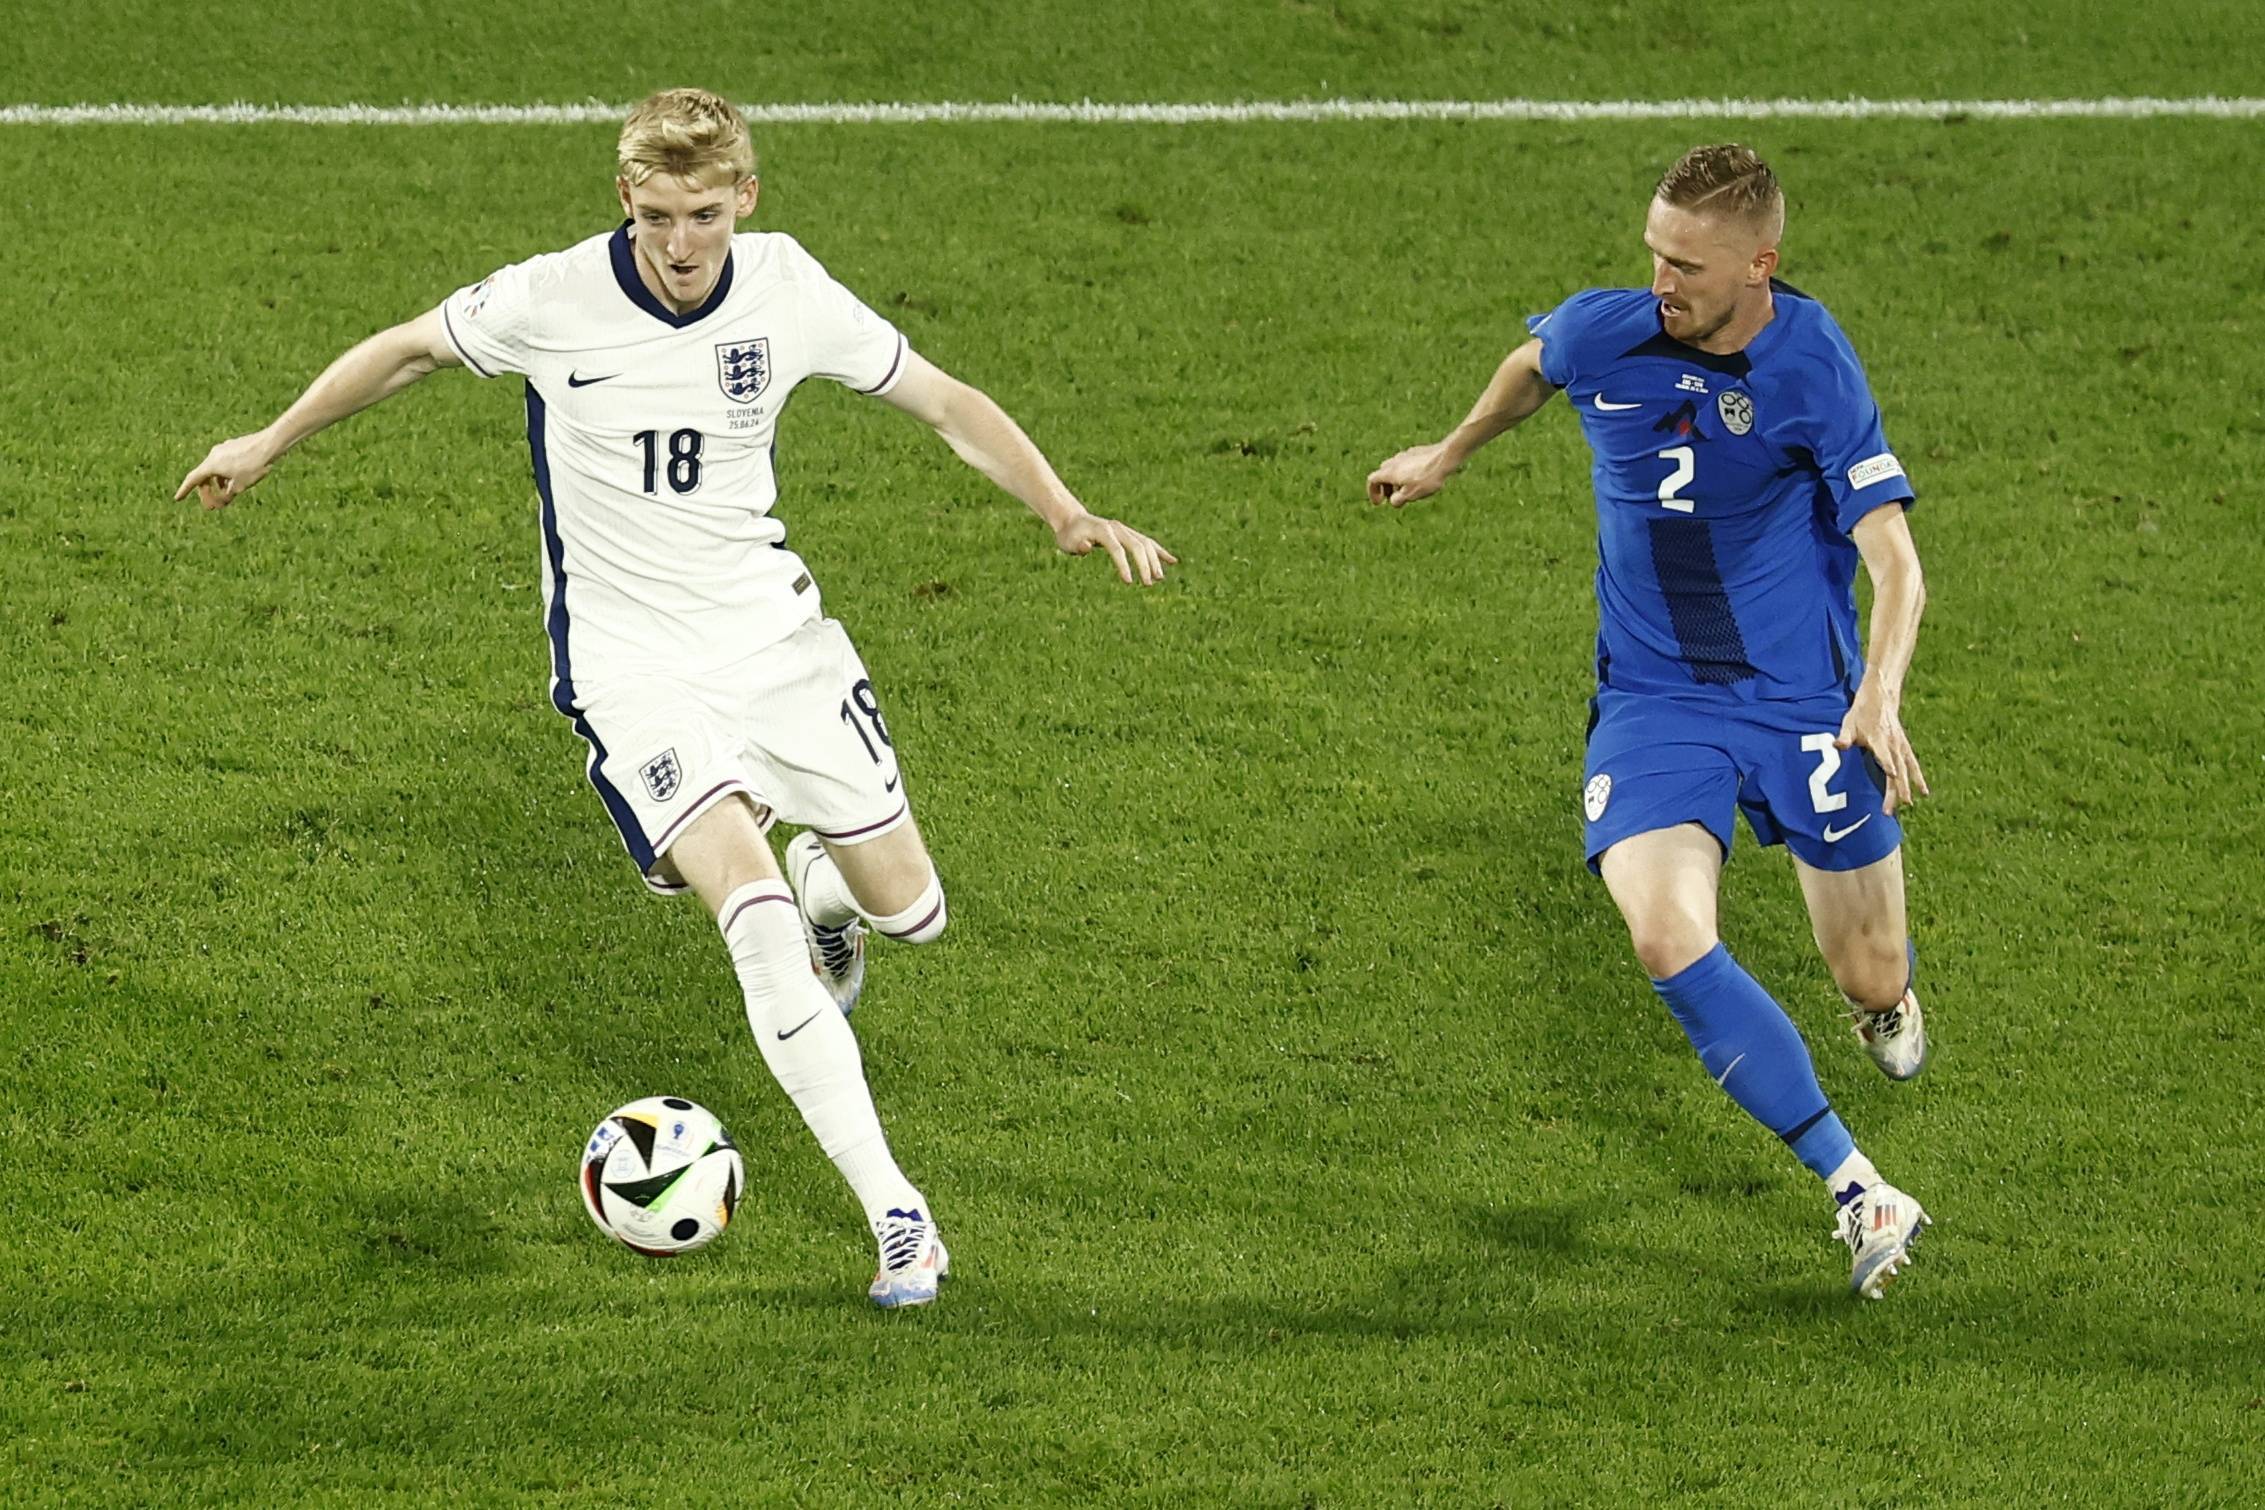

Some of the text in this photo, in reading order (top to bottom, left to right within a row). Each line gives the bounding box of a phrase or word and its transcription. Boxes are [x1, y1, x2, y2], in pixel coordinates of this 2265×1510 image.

[726, 407, 764, 419] SLOVENIA
[633, 428, 704, 496] 18
[1658, 446, 1695, 513] 2
[840, 678, 892, 766] 18
[1801, 732, 1847, 814] 2
